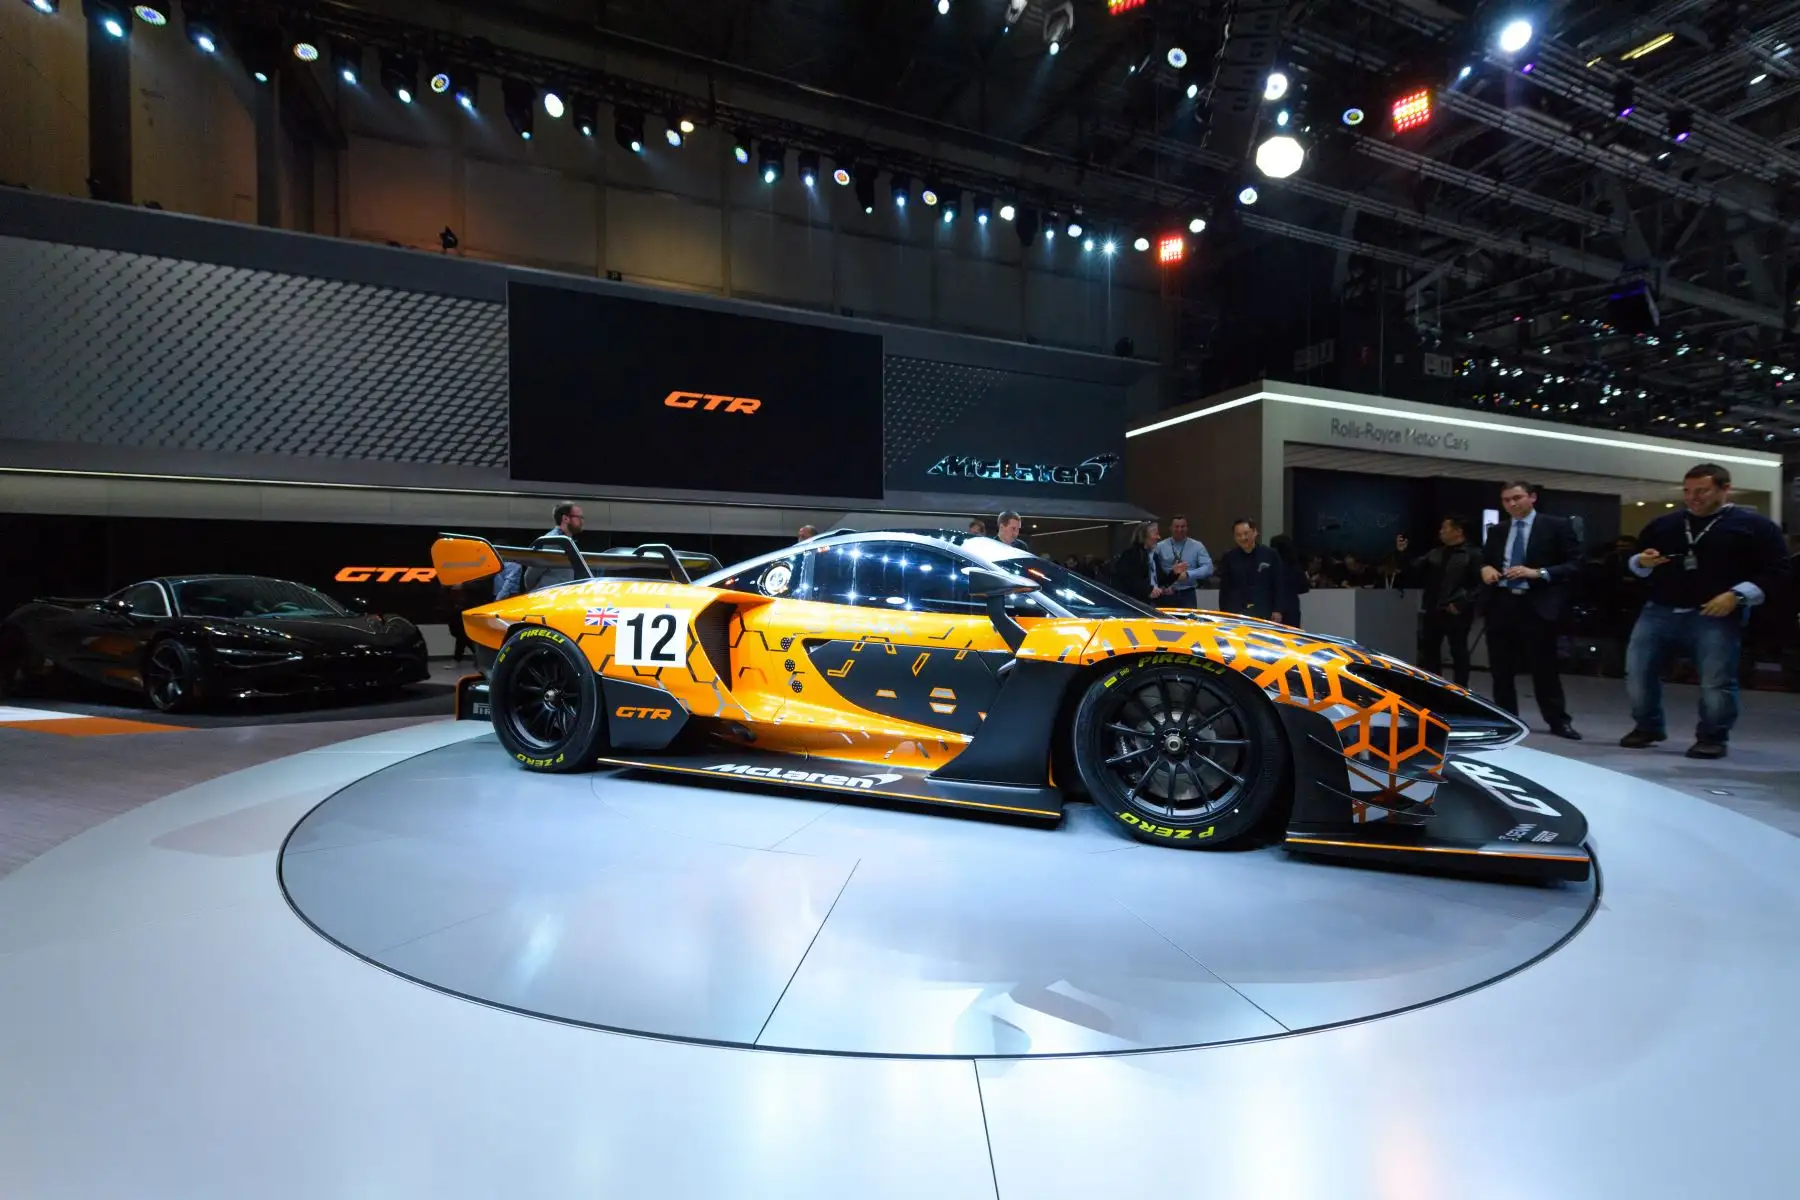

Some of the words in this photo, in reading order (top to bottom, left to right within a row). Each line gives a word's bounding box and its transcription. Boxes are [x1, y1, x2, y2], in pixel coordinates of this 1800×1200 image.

[664, 391, 762, 414] GTR
[1330, 417, 1402, 444] Rolls-Royce
[1405, 428, 1441, 448] Motor
[1443, 433, 1470, 451] Cars
[335, 567, 438, 582] GTR
[519, 629, 566, 645] PIRELLI
[626, 613, 677, 662] 12
[1138, 654, 1227, 675] PIRELLI
[615, 706, 672, 721] GTR
[516, 753, 553, 767] ZERO
[556, 753, 564, 763] P
[701, 763, 888, 789] McLaren
[1119, 812, 1193, 839] ZERO
[1198, 826, 1215, 839] P
